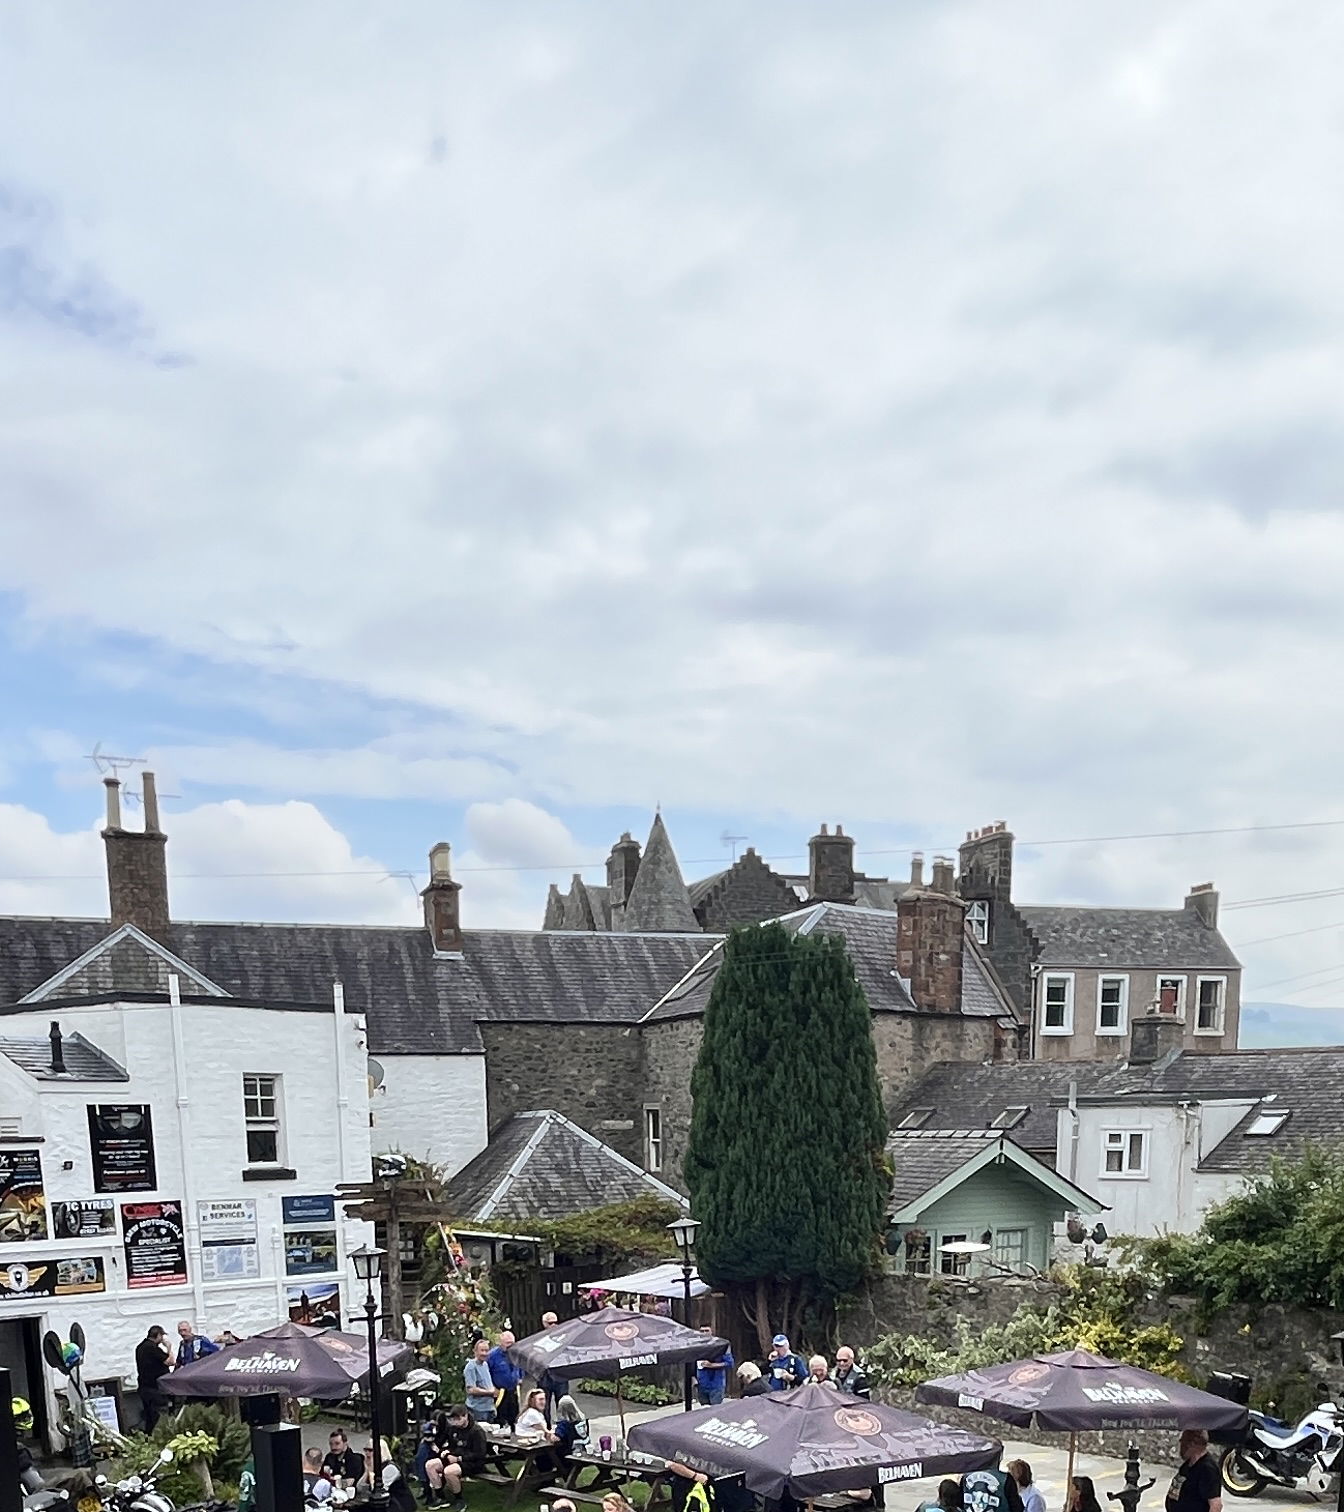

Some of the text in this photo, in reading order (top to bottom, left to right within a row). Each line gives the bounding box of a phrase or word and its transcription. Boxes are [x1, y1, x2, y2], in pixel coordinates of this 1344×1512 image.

[80, 1199, 114, 1211] TYRES
[139, 1218, 184, 1240] MOTORCYCLE
[224, 1356, 302, 1372] BELHAVEN
[694, 1417, 770, 1450] BELHAVEN
[877, 1462, 923, 1484] BELHAVEN
